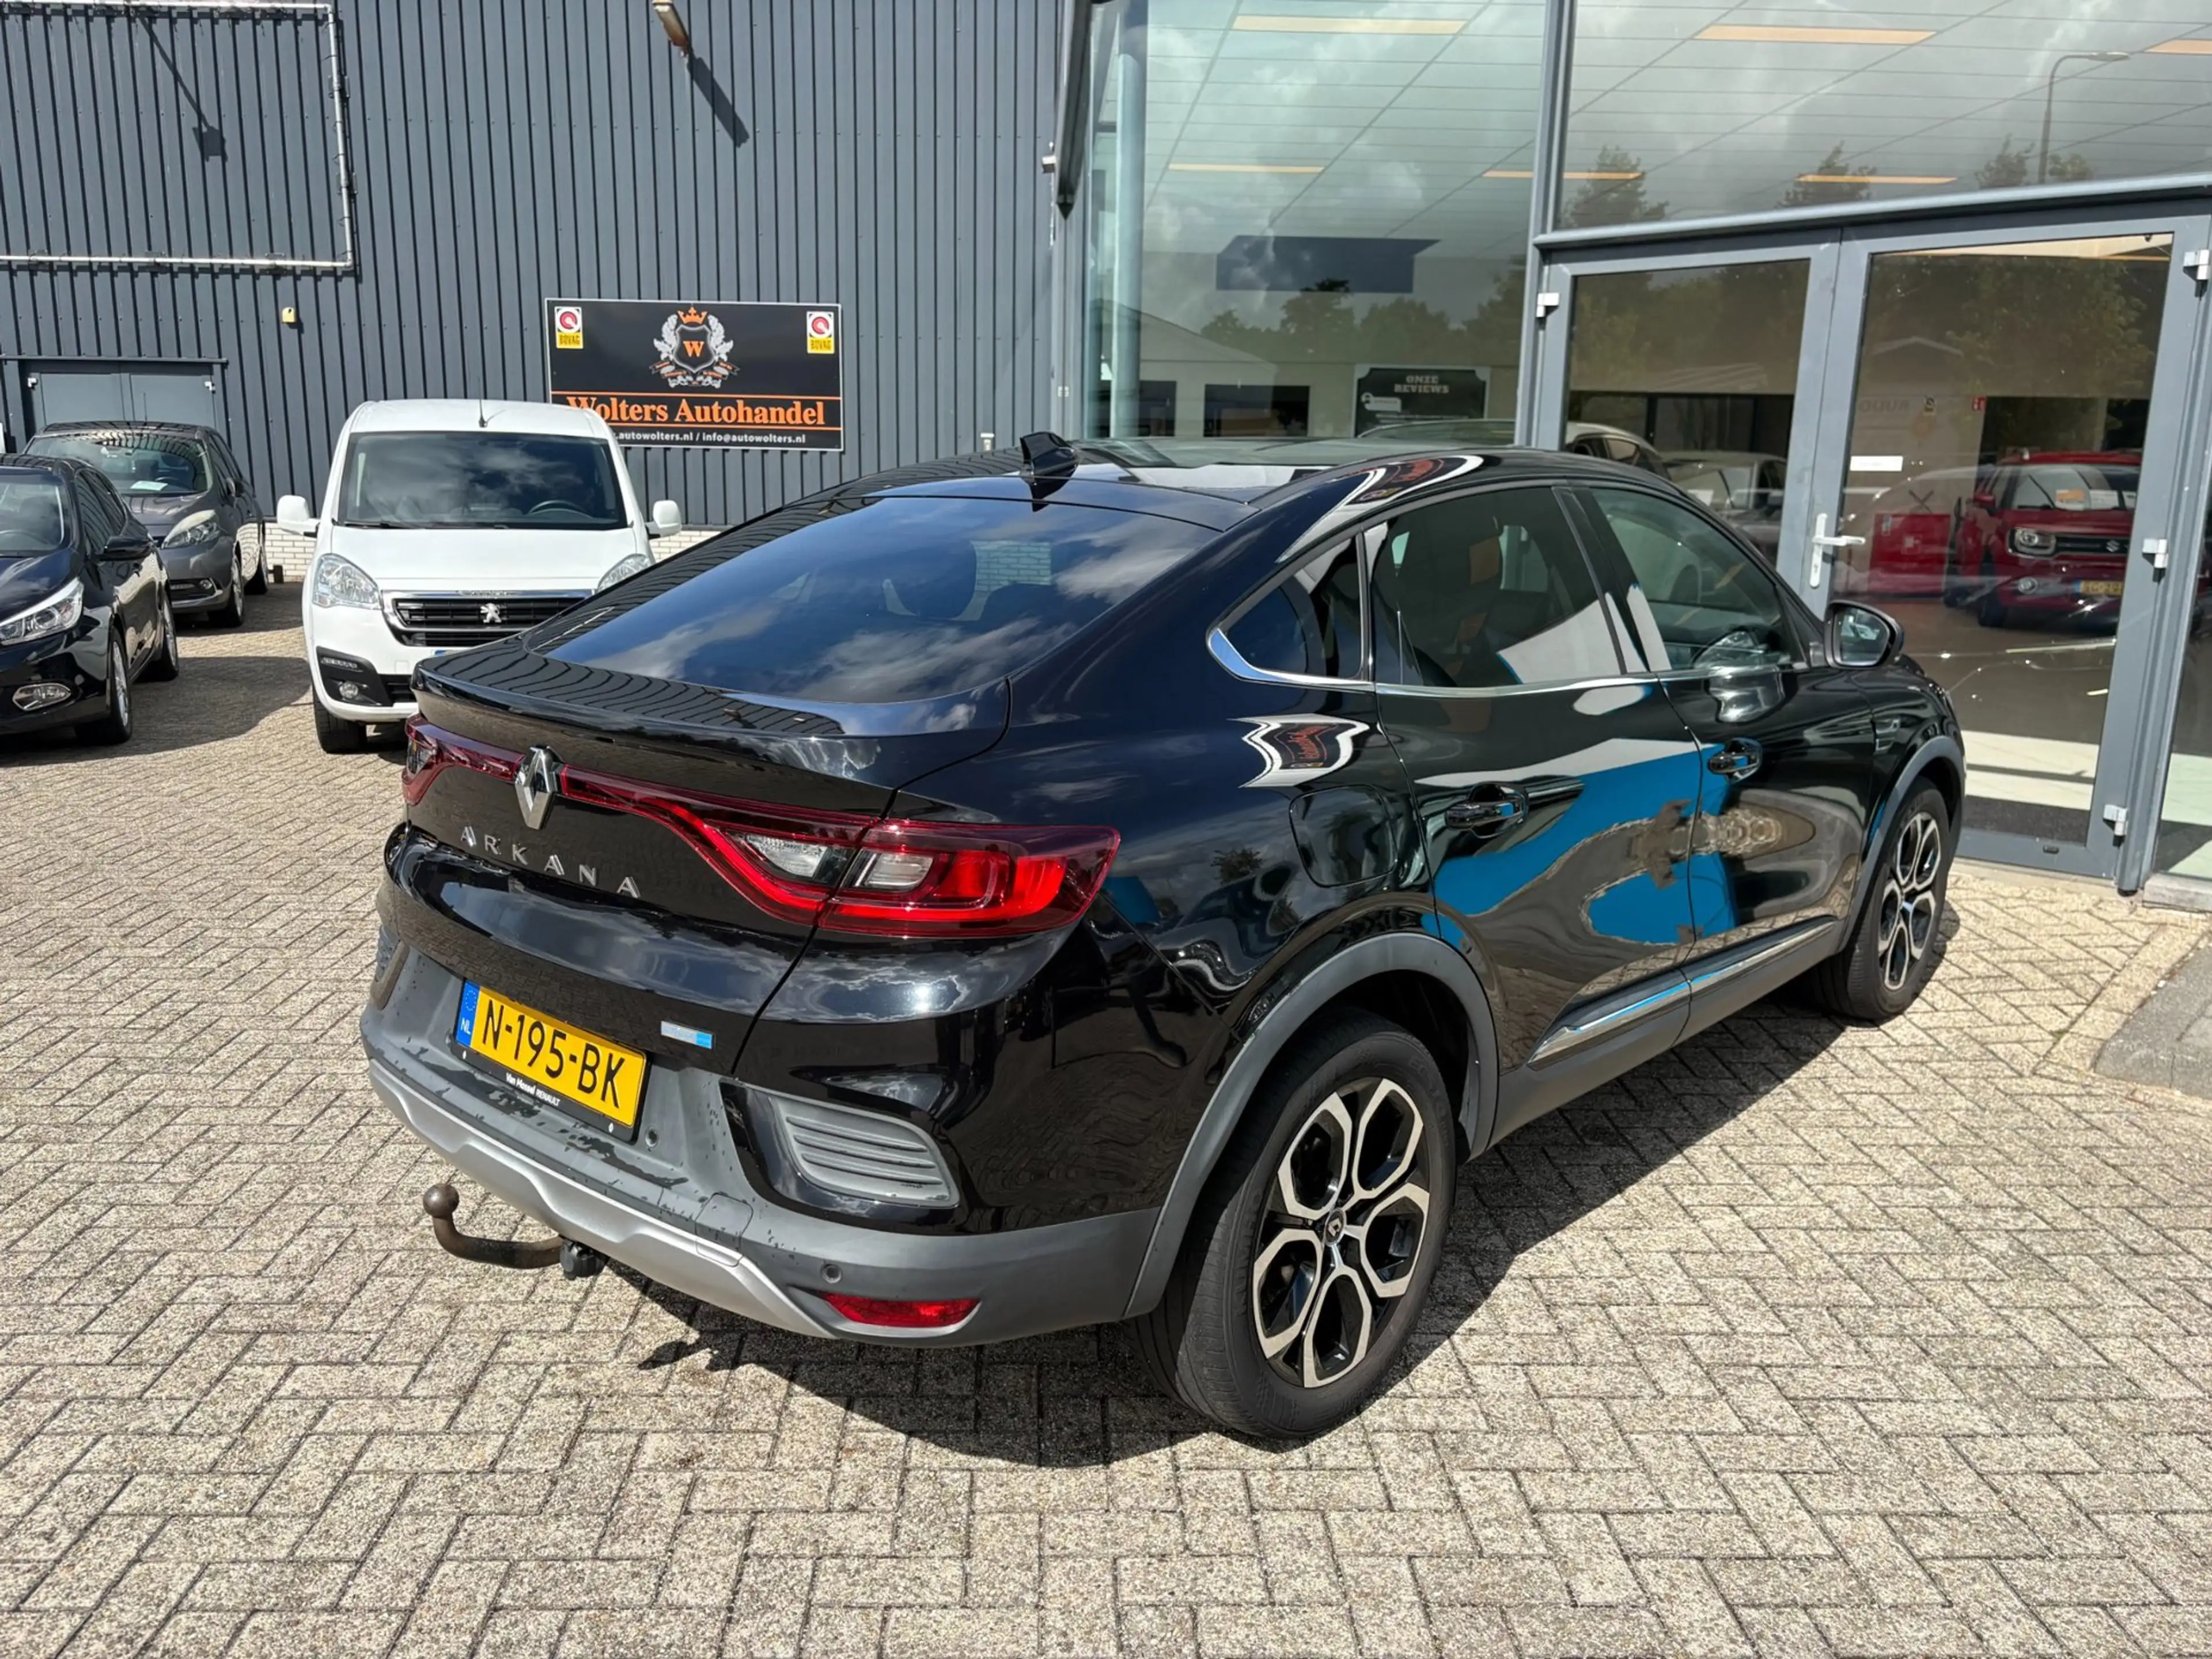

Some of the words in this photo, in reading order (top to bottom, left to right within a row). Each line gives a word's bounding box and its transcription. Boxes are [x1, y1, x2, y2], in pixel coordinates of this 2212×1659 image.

[559, 335, 581, 346] BOVAG
[683, 340, 704, 358] W
[810, 339, 832, 350] BOVAG
[1393, 384, 1449, 393] REVIEWS
[566, 396, 668, 422] Wolters
[675, 399, 825, 426] Autohandel
[702, 431, 806, 444] info@autowolters.nl
[460, 825, 641, 899] ARKANA
[460, 1017, 471, 1035] NL
[482, 998, 626, 1109] N-195-BK
